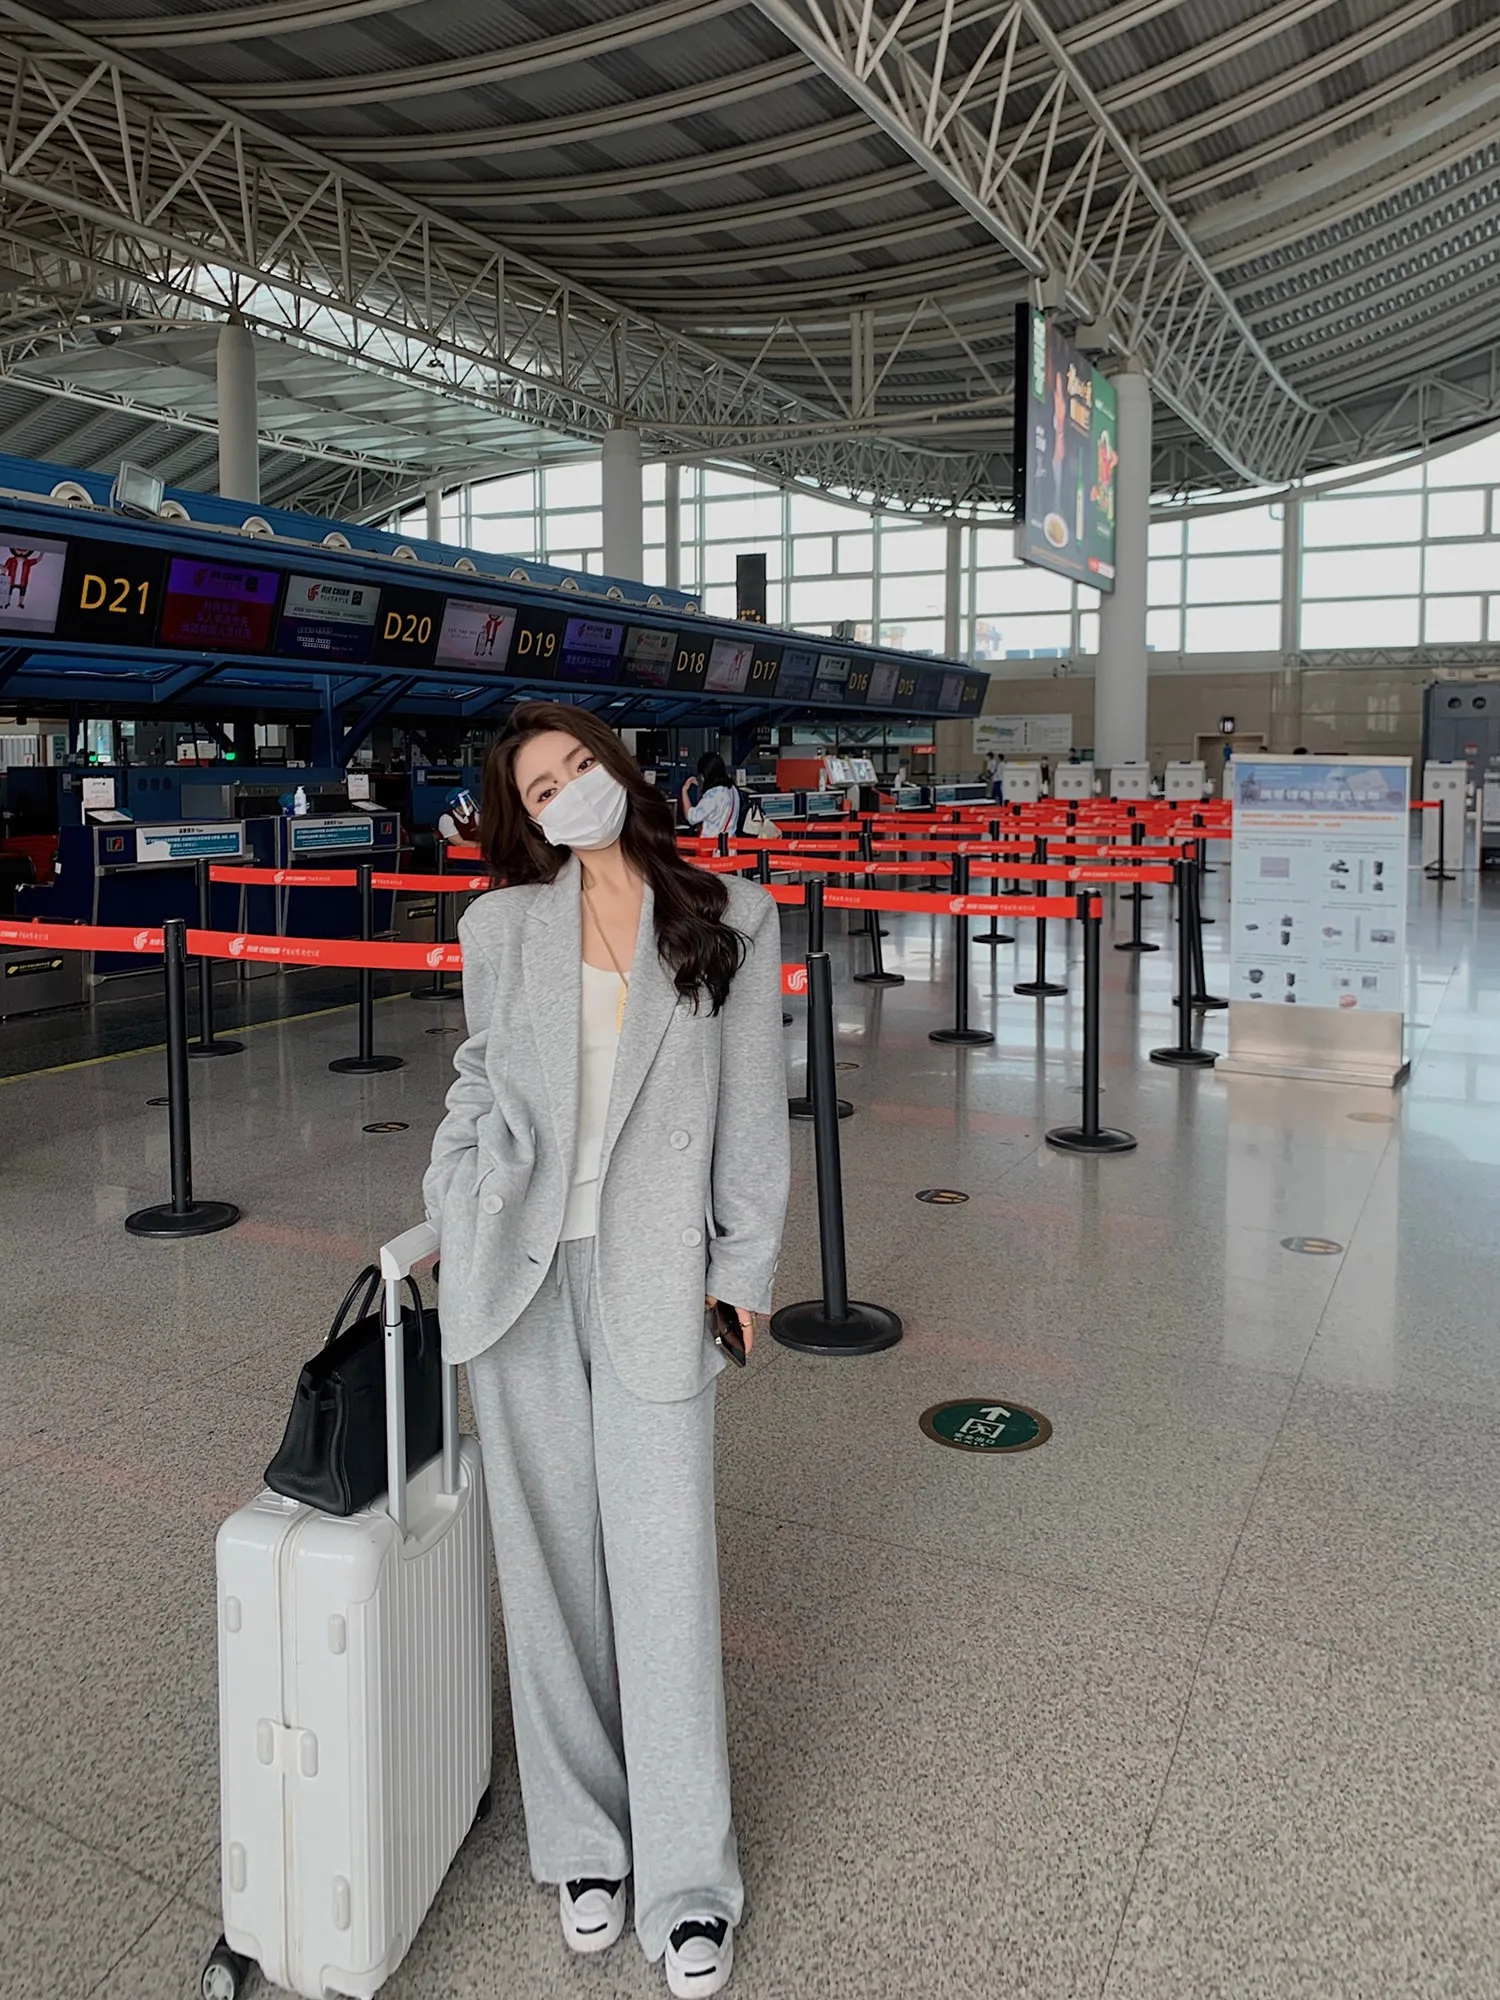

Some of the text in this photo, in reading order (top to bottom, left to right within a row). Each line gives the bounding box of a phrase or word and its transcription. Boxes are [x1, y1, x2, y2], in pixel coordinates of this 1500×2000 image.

[80, 574, 149, 615] D21
[384, 612, 431, 643] D20
[517, 629, 556, 657] D19
[677, 650, 705, 674] D18
[752, 660, 777, 681] D17
[848, 672, 868, 691] D16
[897, 678, 916, 696] D15
[246, 945, 259, 953] AIR
[259, 946, 280, 955] CHINA
[446, 955, 460, 963] AIR
